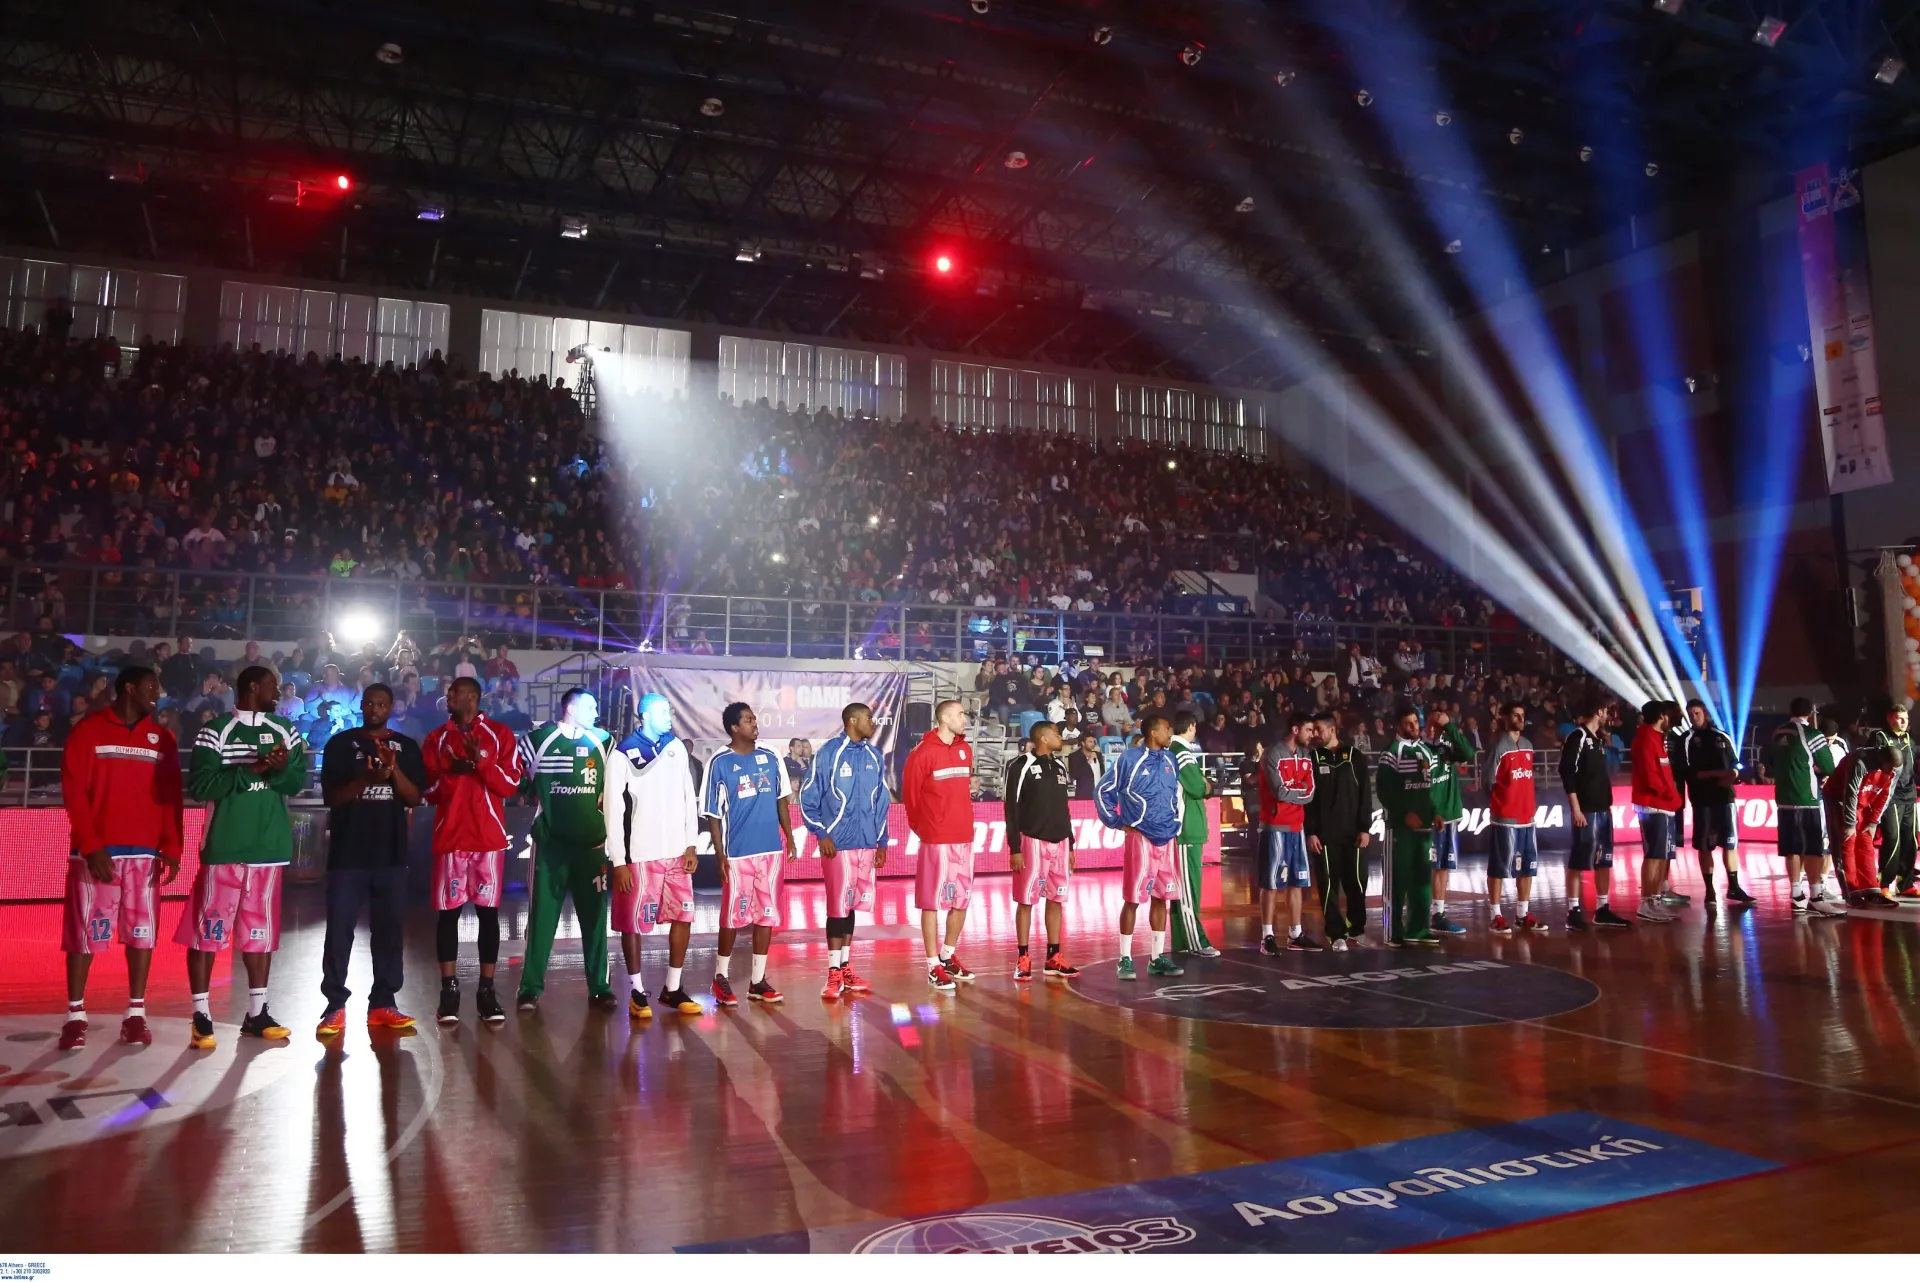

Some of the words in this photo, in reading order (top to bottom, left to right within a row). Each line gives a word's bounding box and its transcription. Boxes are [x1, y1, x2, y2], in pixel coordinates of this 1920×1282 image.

[796, 685, 850, 709] GAME
[757, 713, 796, 727] 014
[115, 746, 151, 756] OLYMPIACOS
[580, 767, 598, 785] 18
[1281, 866, 1288, 882] 4
[943, 884, 955, 901] 10
[643, 903, 658, 922] 15
[91, 919, 111, 942] 12
[203, 919, 223, 941] 14
[1279, 960, 1511, 990] AEGEAN
[1232, 1135, 1664, 1227] Ασφαλιστική
